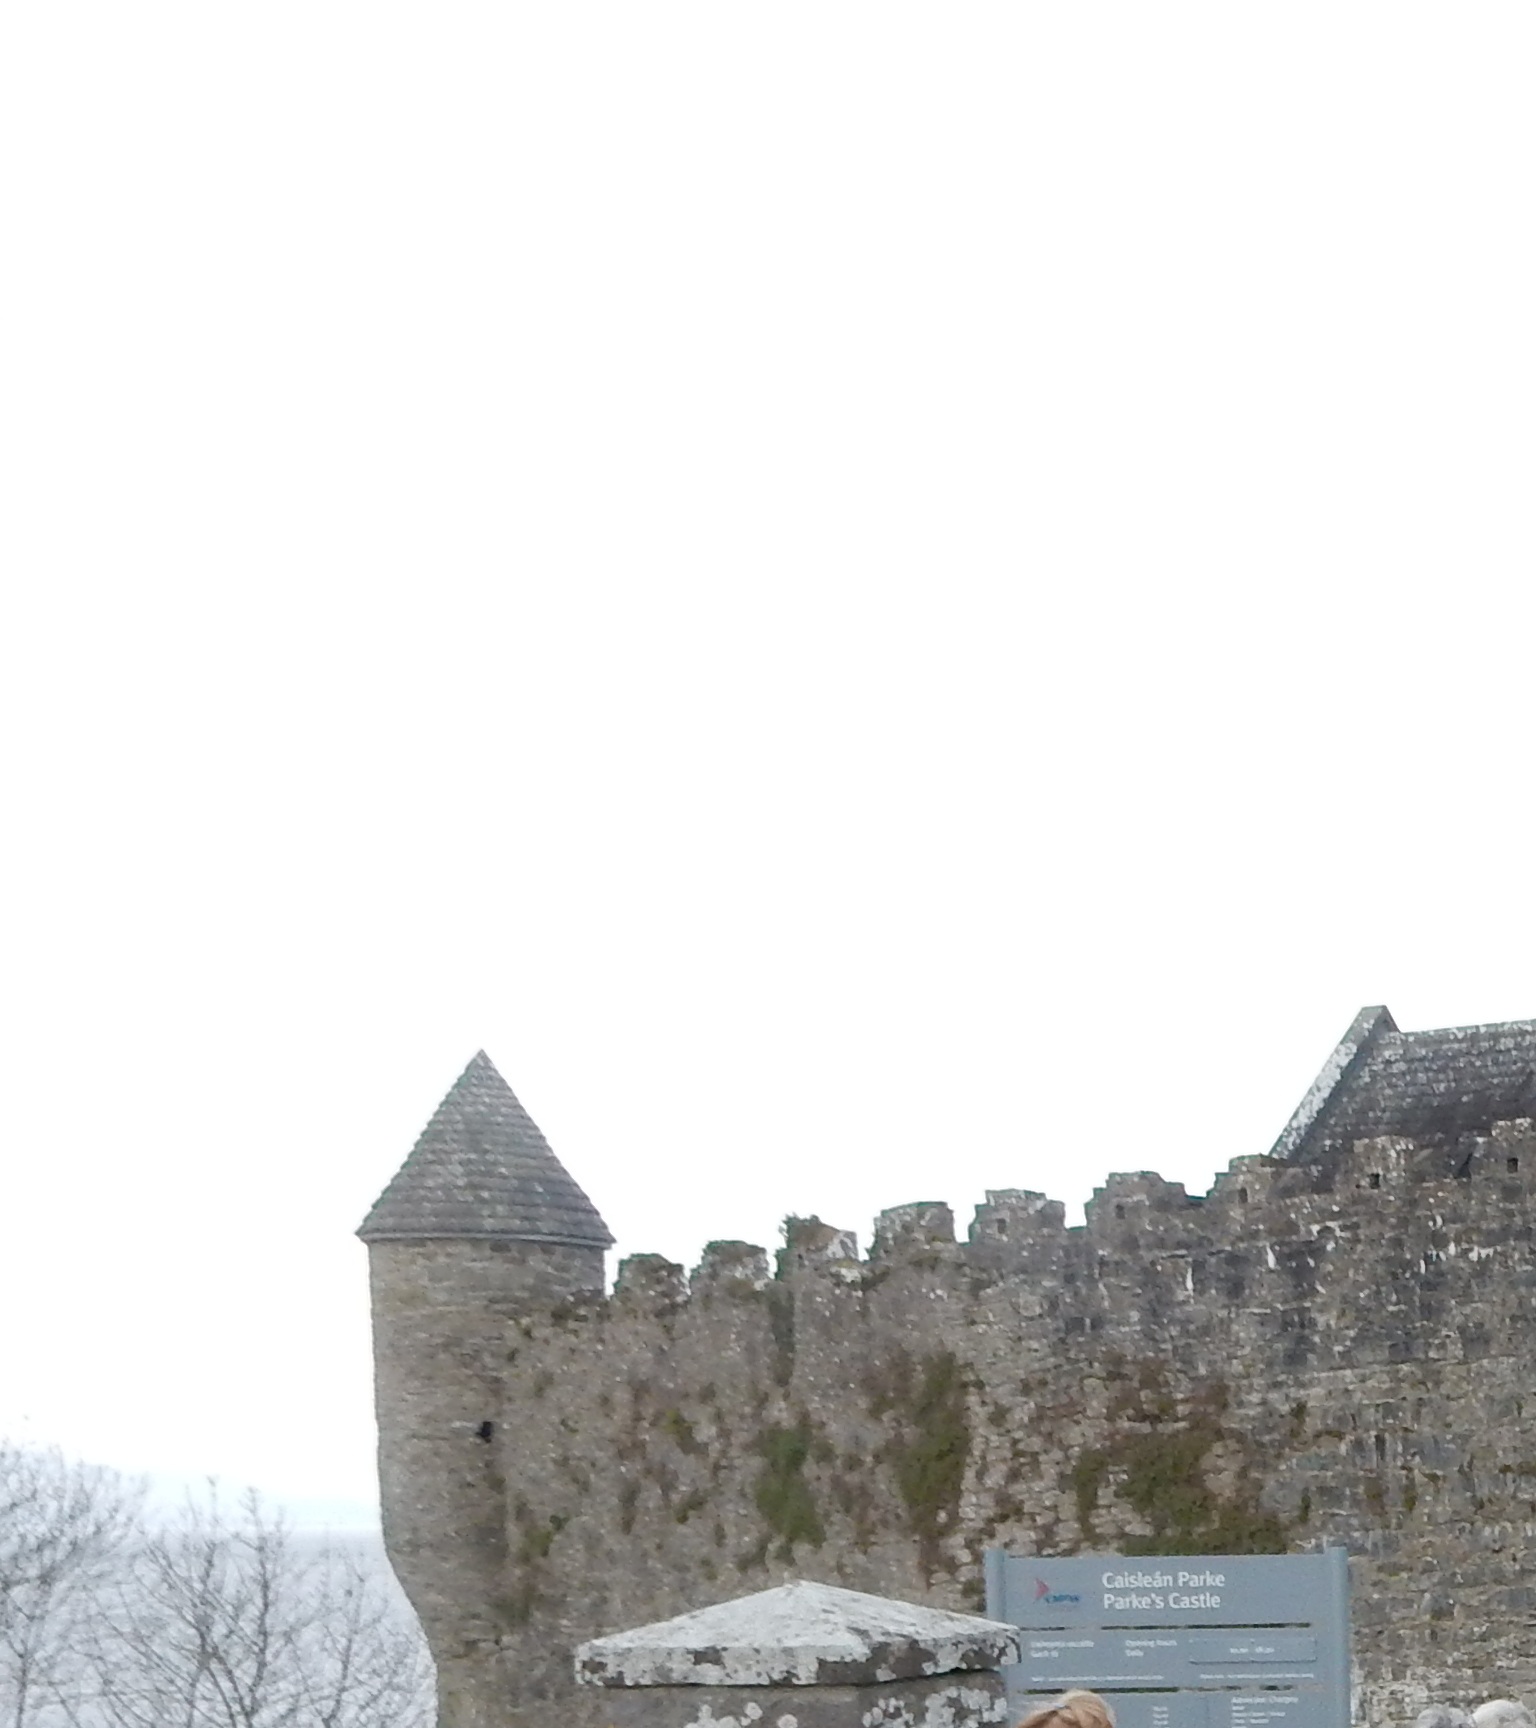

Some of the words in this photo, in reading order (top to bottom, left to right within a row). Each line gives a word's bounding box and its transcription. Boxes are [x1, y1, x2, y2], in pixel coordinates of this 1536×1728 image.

[1101, 1571, 1173, 1589] Caisleán
[1177, 1570, 1225, 1587] Parke
[1103, 1592, 1165, 1609] Parke's
[1168, 1592, 1221, 1609] Castle
